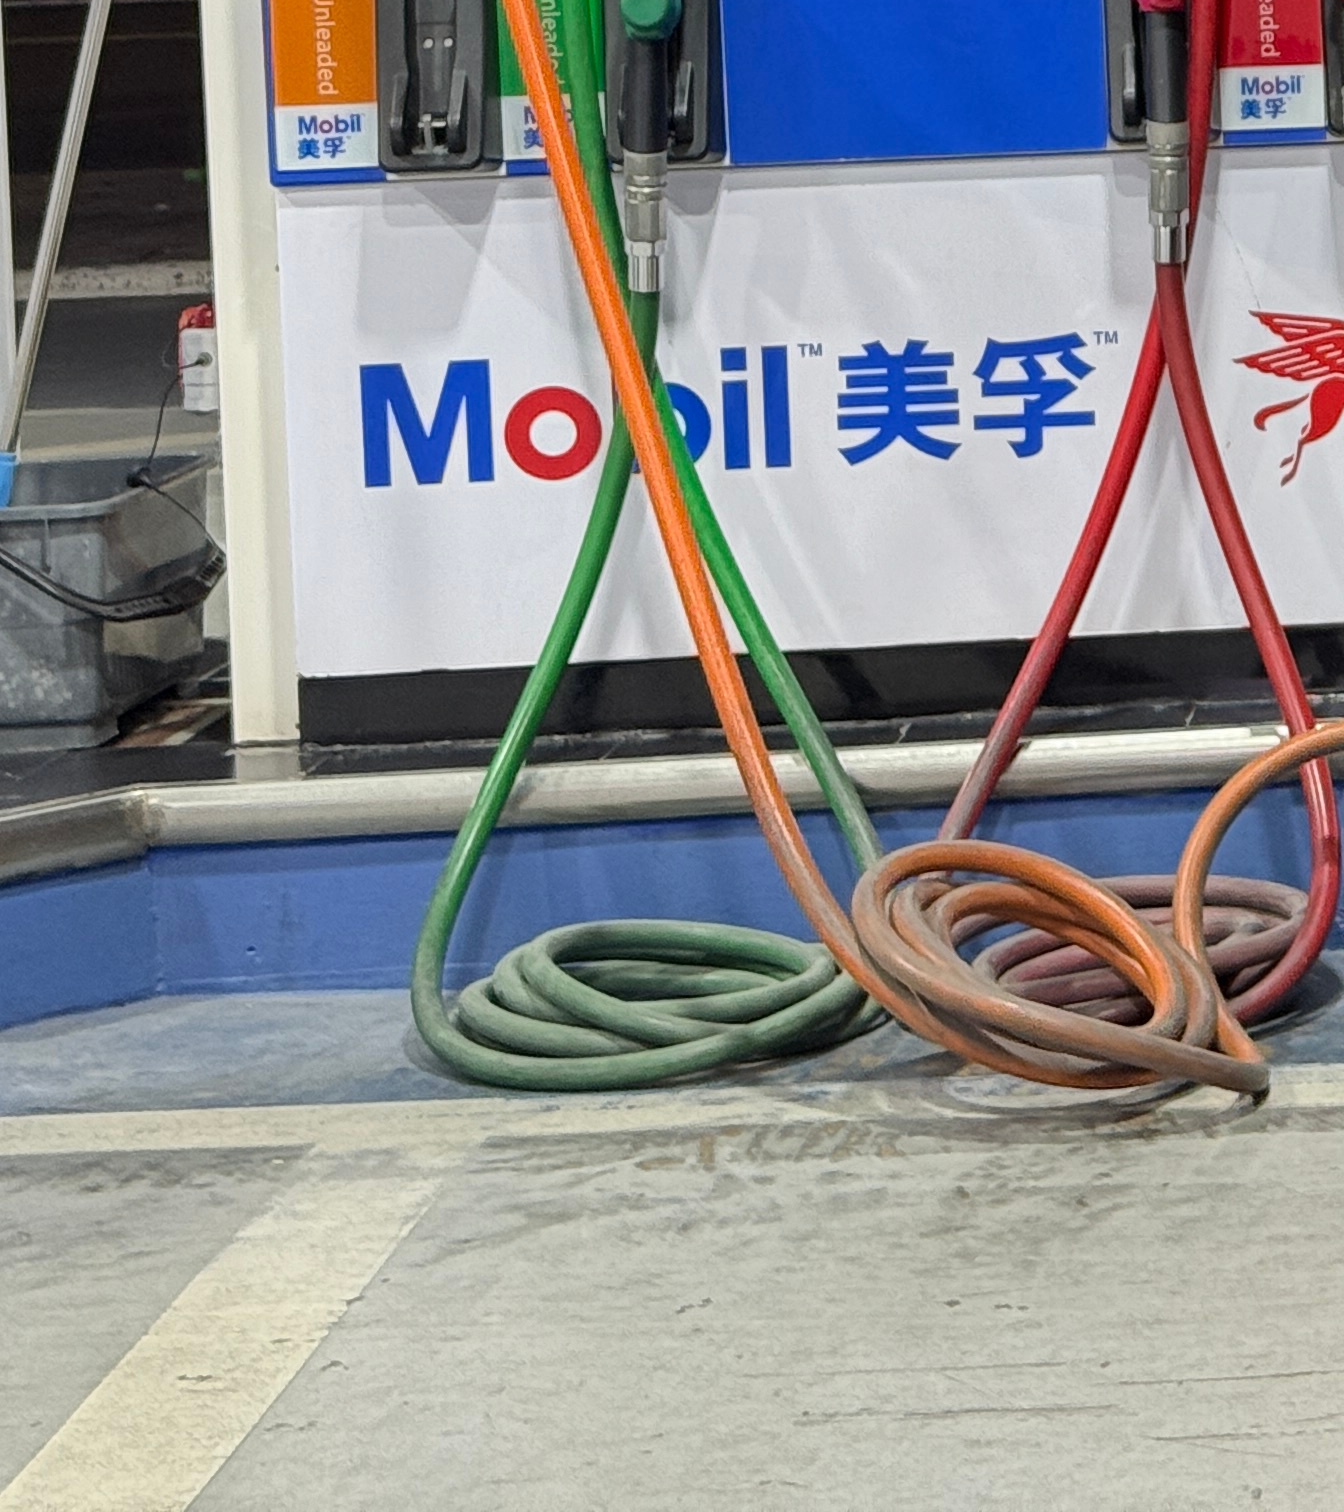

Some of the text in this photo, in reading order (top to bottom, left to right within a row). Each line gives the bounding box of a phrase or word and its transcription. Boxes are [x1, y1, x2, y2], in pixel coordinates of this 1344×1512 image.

[1240, 75, 1301, 96] Mobil
[1240, 98, 1287, 120] 美孚
[297, 113, 363, 135] Mobil
[297, 137, 345, 160] 美孚
[836, 332, 1096, 466] 美孚
